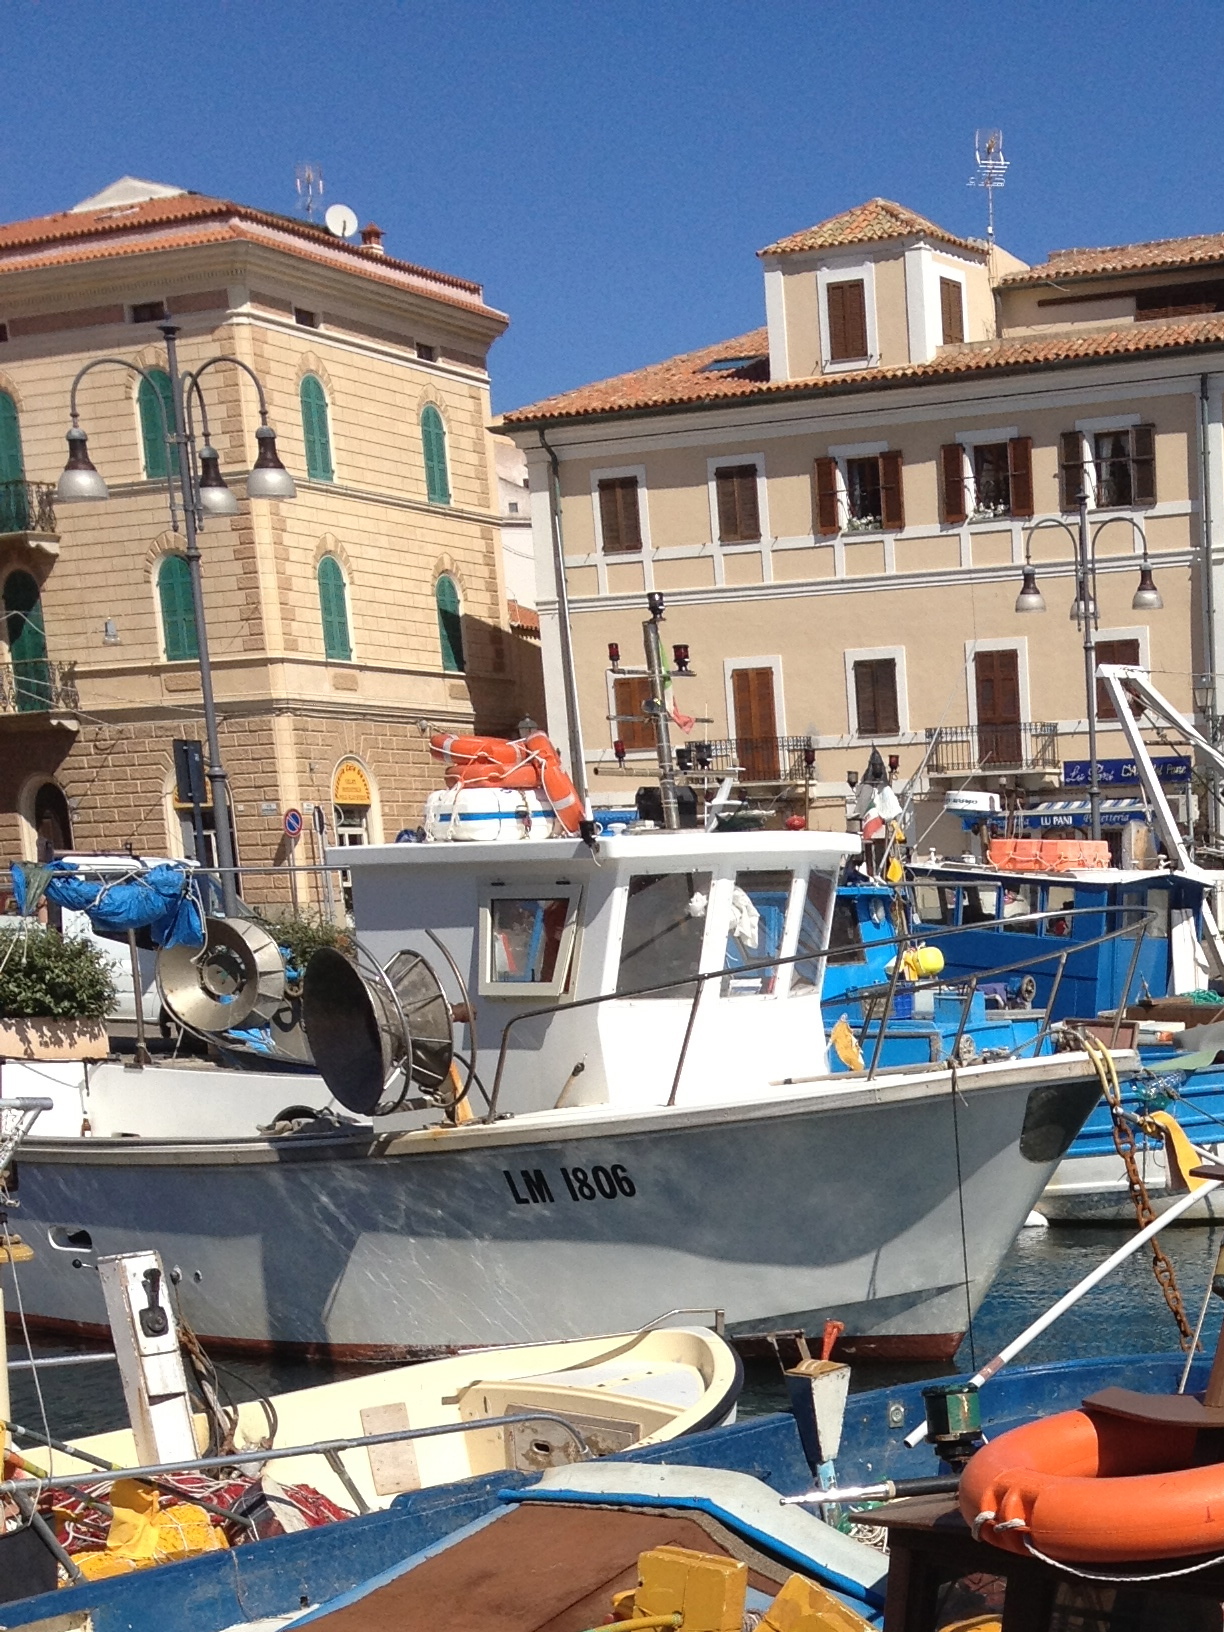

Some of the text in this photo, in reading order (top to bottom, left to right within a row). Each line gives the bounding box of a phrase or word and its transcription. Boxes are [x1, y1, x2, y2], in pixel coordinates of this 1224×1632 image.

[1041, 816, 1050, 826] LU
[1053, 815, 1073, 825] PANI
[503, 1164, 636, 1204] LM 1806
